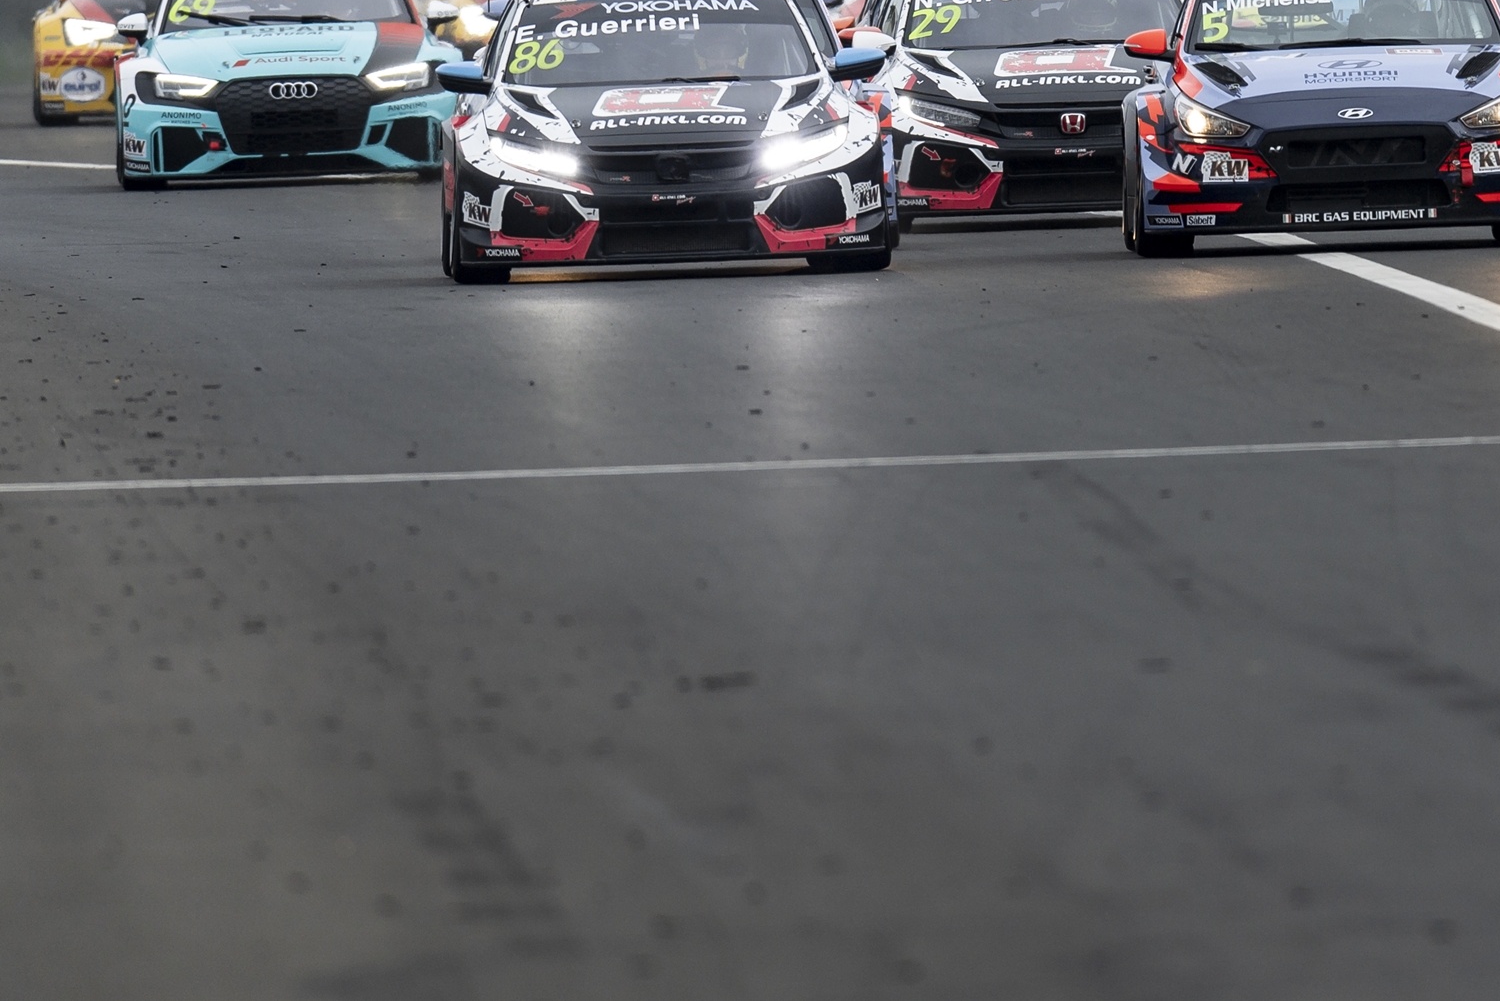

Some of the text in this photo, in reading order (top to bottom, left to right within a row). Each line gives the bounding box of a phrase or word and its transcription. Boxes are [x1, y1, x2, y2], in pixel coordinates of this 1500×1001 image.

[601, 0, 759, 13] YOKOHAMA
[514, 13, 701, 45] E. Guerrieri
[908, 5, 962, 40] 29
[1202, 9, 1229, 44] 5
[255, 55, 348, 65] Audi Sport
[508, 38, 565, 74] 86
[1304, 69, 1399, 79] HYUNDAI
[1305, 76, 1398, 85] MOTORSPORT
[387, 101, 428, 111] ANONIMO
[161, 112, 202, 120] ANONIMO
[125, 138, 146, 154] KW
[1210, 160, 1247, 176] KW
[859, 185, 879, 208] KW
[469, 202, 491, 224] KW
[1294, 208, 1426, 223] BRC GAS EQUIPMENT
[1154, 216, 1181, 224] YOKOHAMA
[1188, 215, 1214, 225] Sabelt
[839, 234, 870, 244] YOKOHAMA
[485, 248, 520, 257] YOKOHAMA
